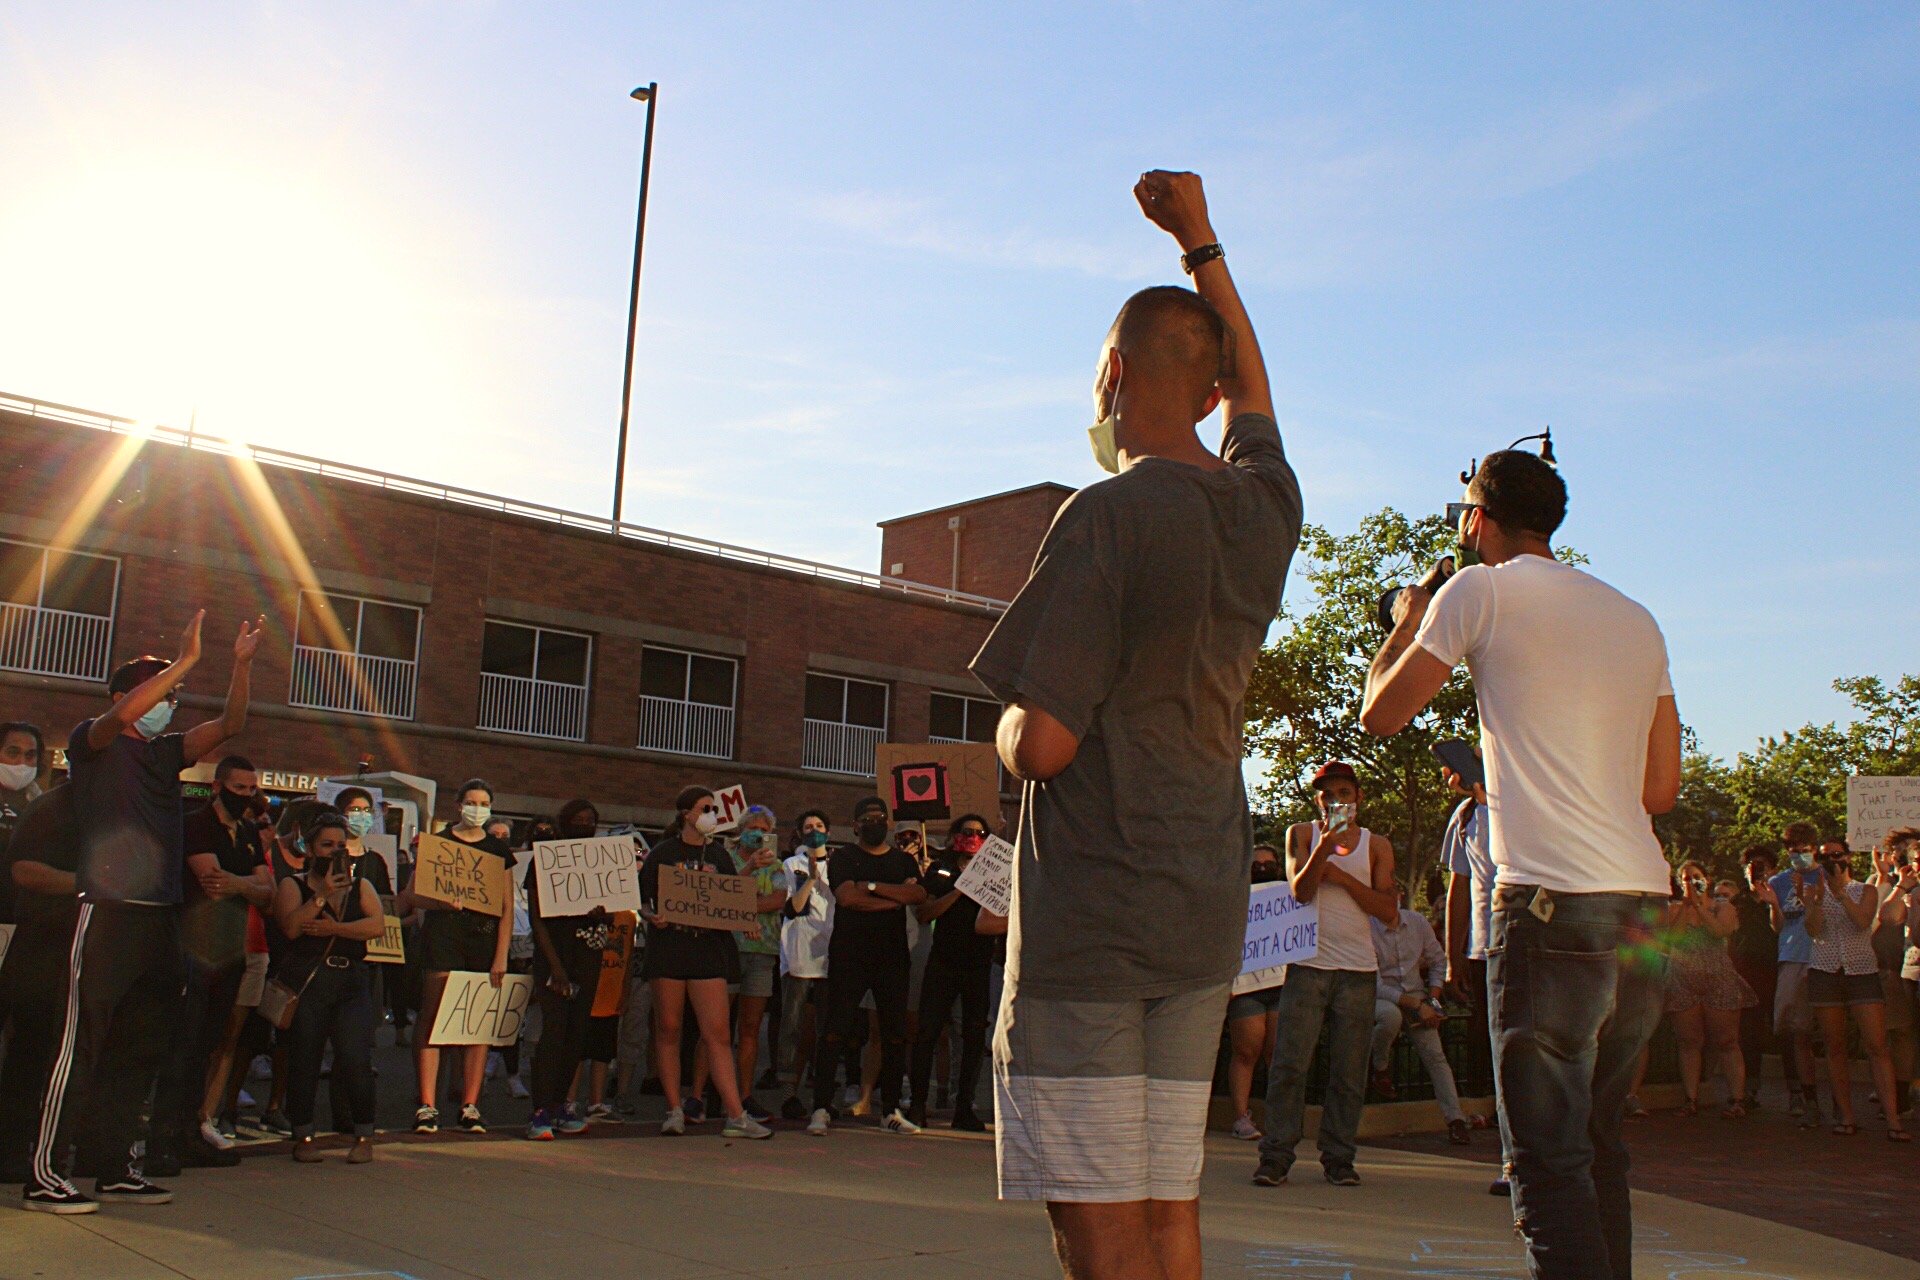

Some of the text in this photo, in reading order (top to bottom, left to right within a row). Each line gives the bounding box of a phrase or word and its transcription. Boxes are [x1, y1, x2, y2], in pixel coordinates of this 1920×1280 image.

[185, 787, 210, 797] OPEN
[262, 771, 323, 790] ENTRA
[1851, 777, 1890, 790] POLICE
[1859, 793, 1887, 805] THAT
[1857, 808, 1903, 821] KILLER
[1854, 826, 1881, 840] ARE
[437, 841, 483, 872] SAY
[539, 843, 634, 871] DEFUND
[550, 868, 633, 903] POLICE
[673, 870, 743, 894] SILENCE
[696, 890, 711, 902] IS
[664, 899, 757, 922] COMPLACENCY
[1254, 894, 1311, 922] BLACKN
[1243, 922, 1317, 961] ISN'T A CRIME
[441, 980, 528, 1038] ACAB
